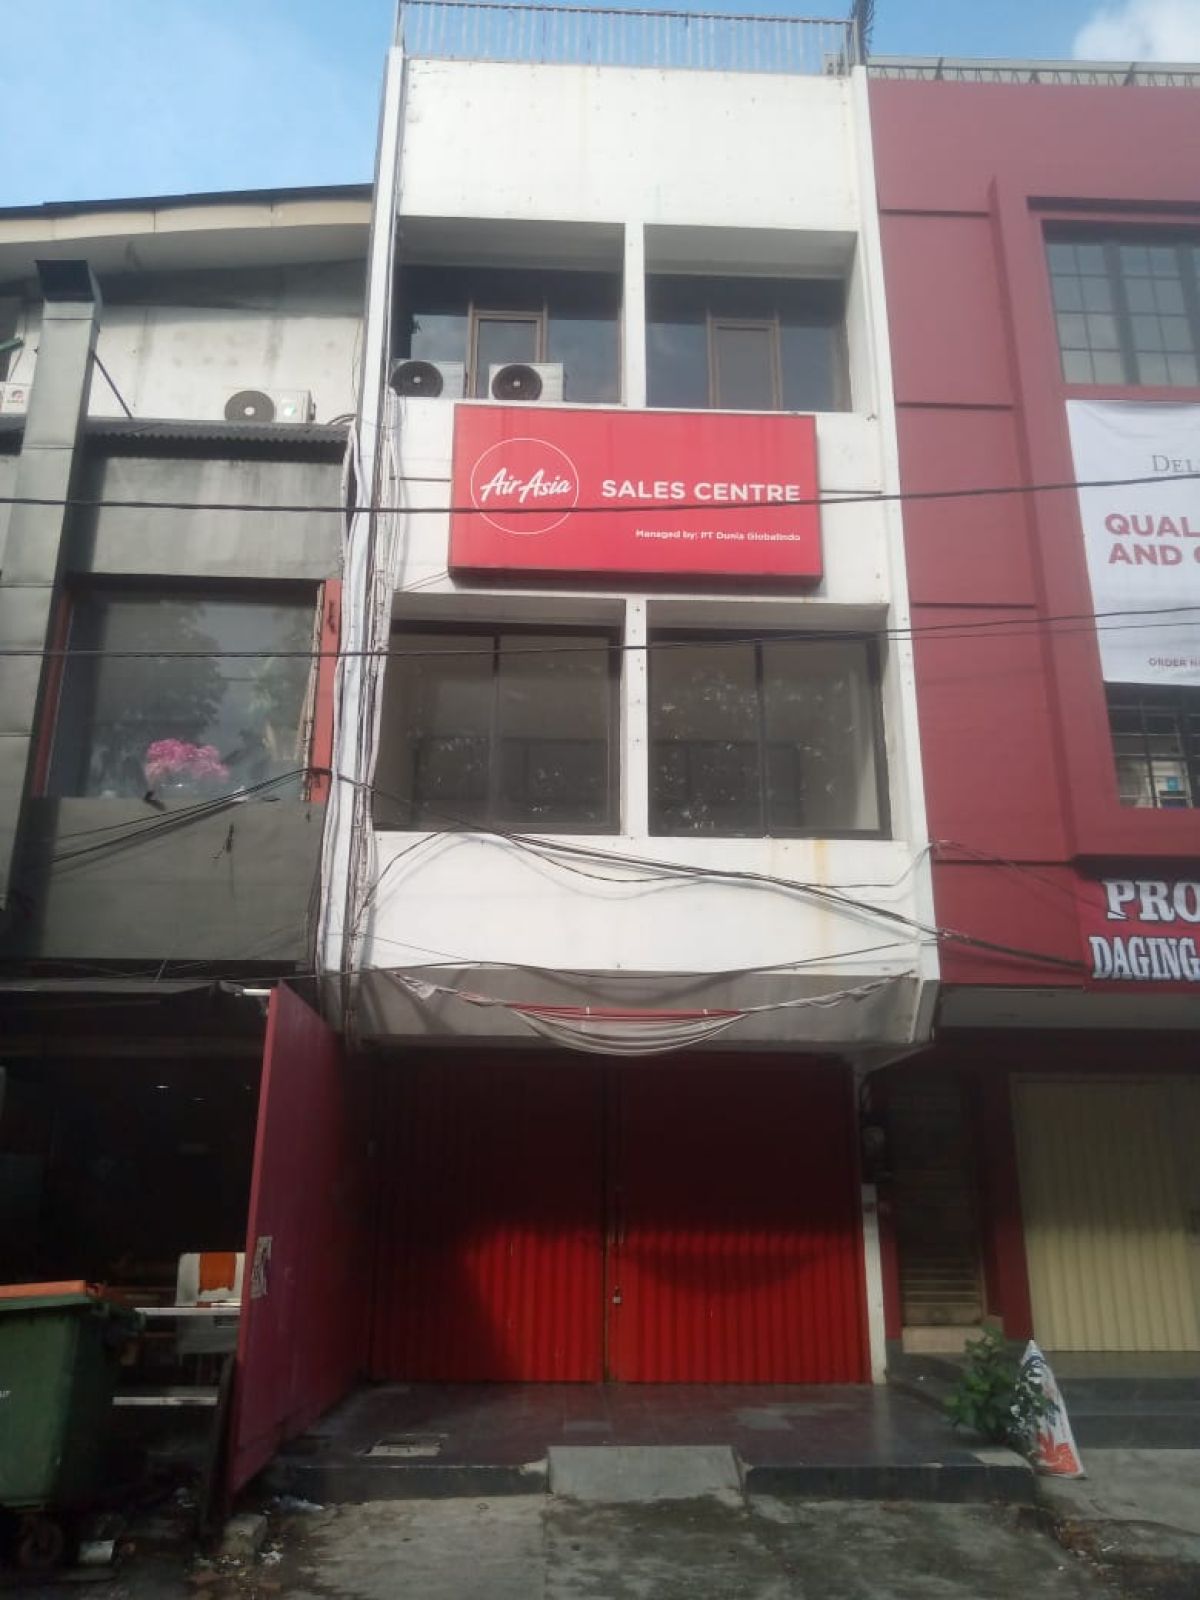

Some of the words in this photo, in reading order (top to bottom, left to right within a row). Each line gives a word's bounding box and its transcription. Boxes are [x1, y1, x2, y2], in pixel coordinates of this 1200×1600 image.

[602, 479, 686, 500] SALES
[694, 482, 801, 502] CENTRE
[636, 529, 681, 540] Managed
[700, 531, 714, 540] PT
[717, 531, 744, 541] Dunia
[748, 532, 801, 542] Globalindo
[1104, 513, 1200, 538] QUAL
[1108, 542, 1183, 566] AND
[1149, 657, 1187, 667] ORDER
[1102, 880, 1200, 923] PRO
[1088, 935, 1200, 981] DAGING
